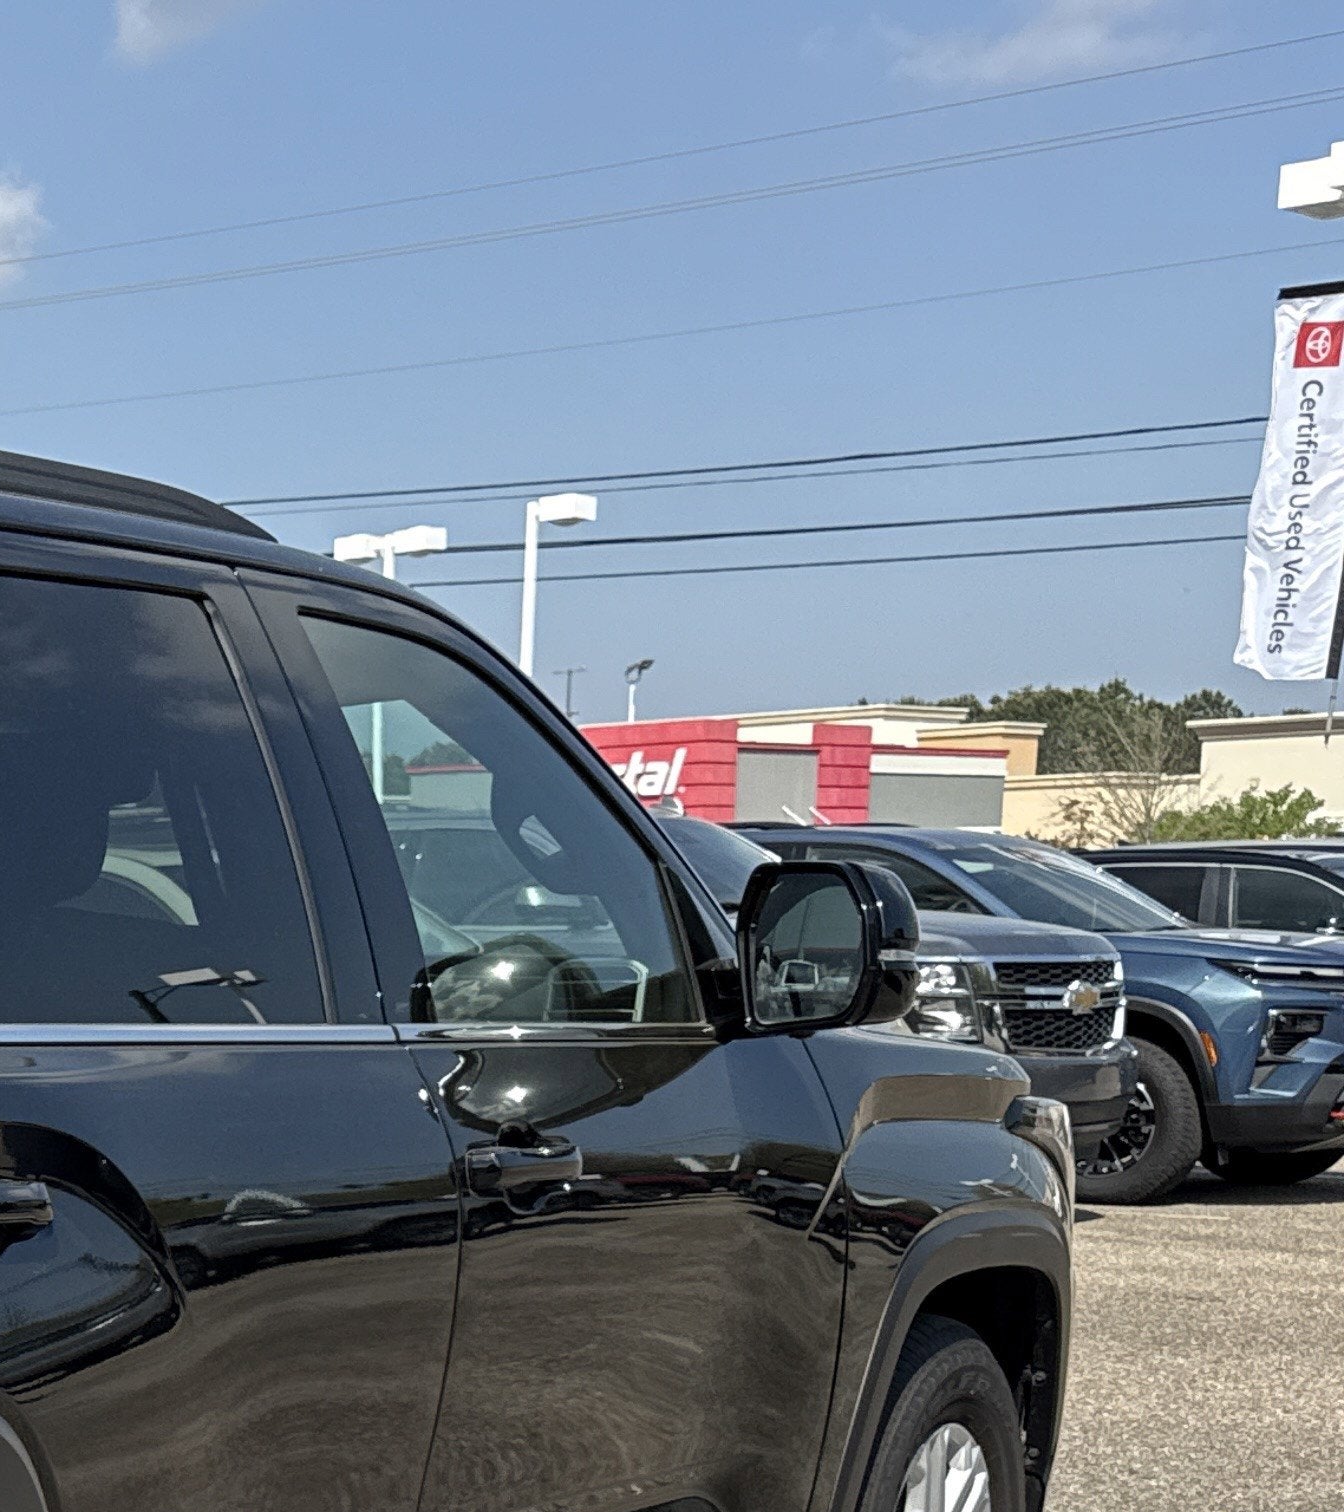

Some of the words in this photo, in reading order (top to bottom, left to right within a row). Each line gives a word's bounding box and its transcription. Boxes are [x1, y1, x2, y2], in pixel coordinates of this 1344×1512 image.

[1291, 379, 1324, 486] Certified
[1283, 492, 1311, 551] Used
[1266, 556, 1304, 655] Vehicles
